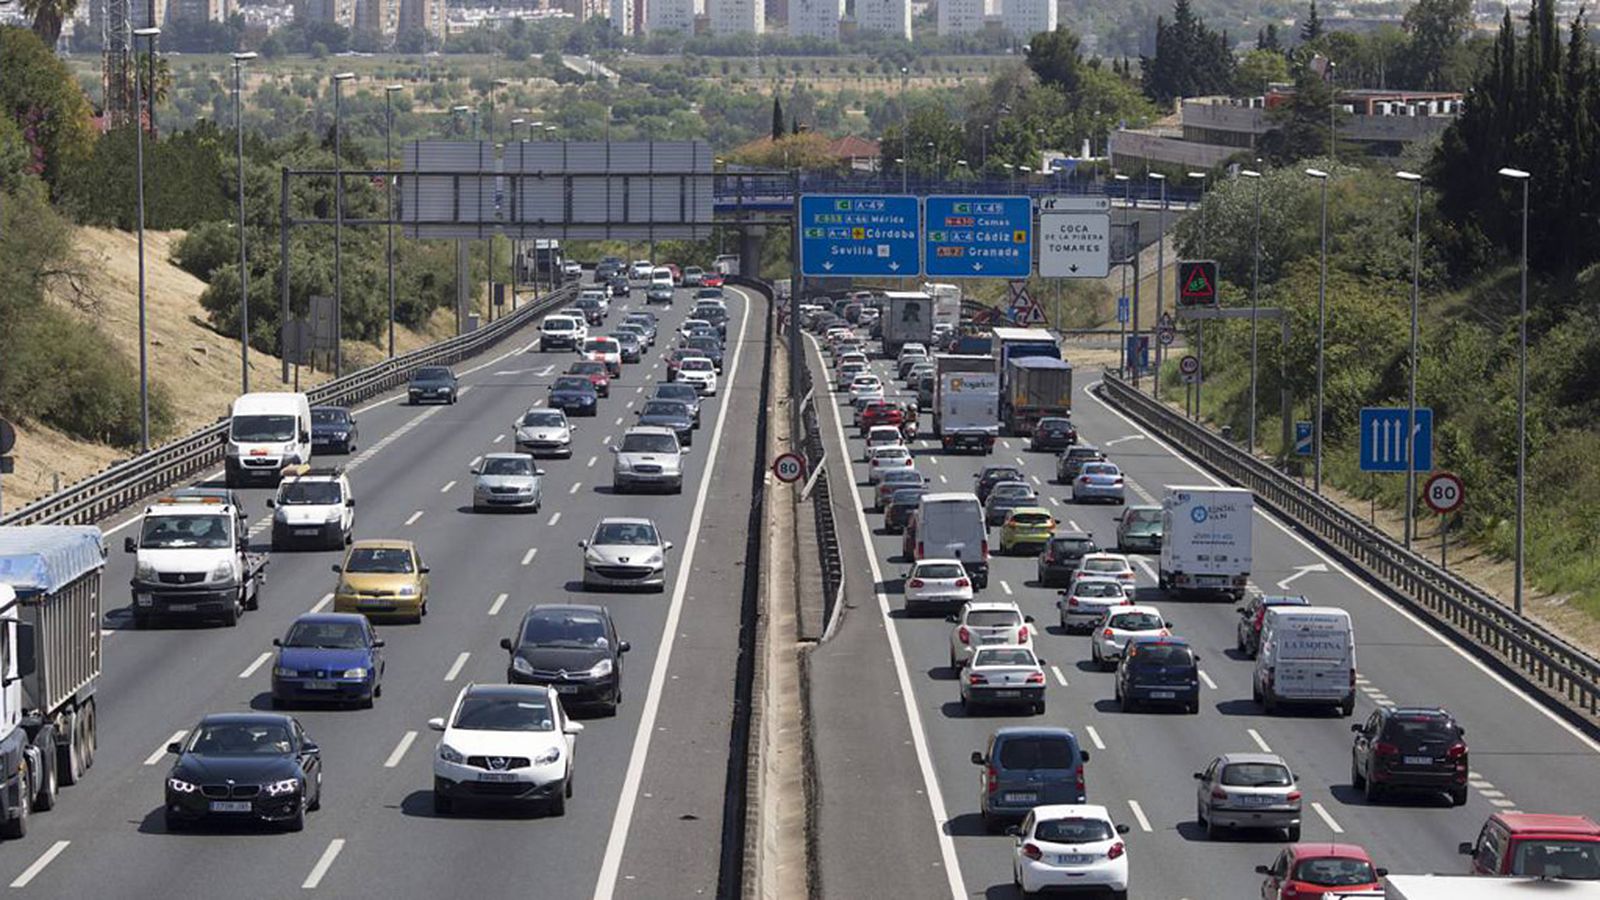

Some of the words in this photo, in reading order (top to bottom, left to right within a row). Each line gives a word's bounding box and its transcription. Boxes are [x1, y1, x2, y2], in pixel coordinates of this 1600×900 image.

[866, 228, 915, 239] Córdoba
[1060, 225, 1089, 233] COCA
[976, 231, 1010, 241] Cádiz
[831, 245, 874, 255] Sevilla
[969, 247, 1018, 256] Granada
[1049, 244, 1100, 252] TOMARES
[780, 462, 798, 474] 80
[1433, 486, 1456, 500] 80
